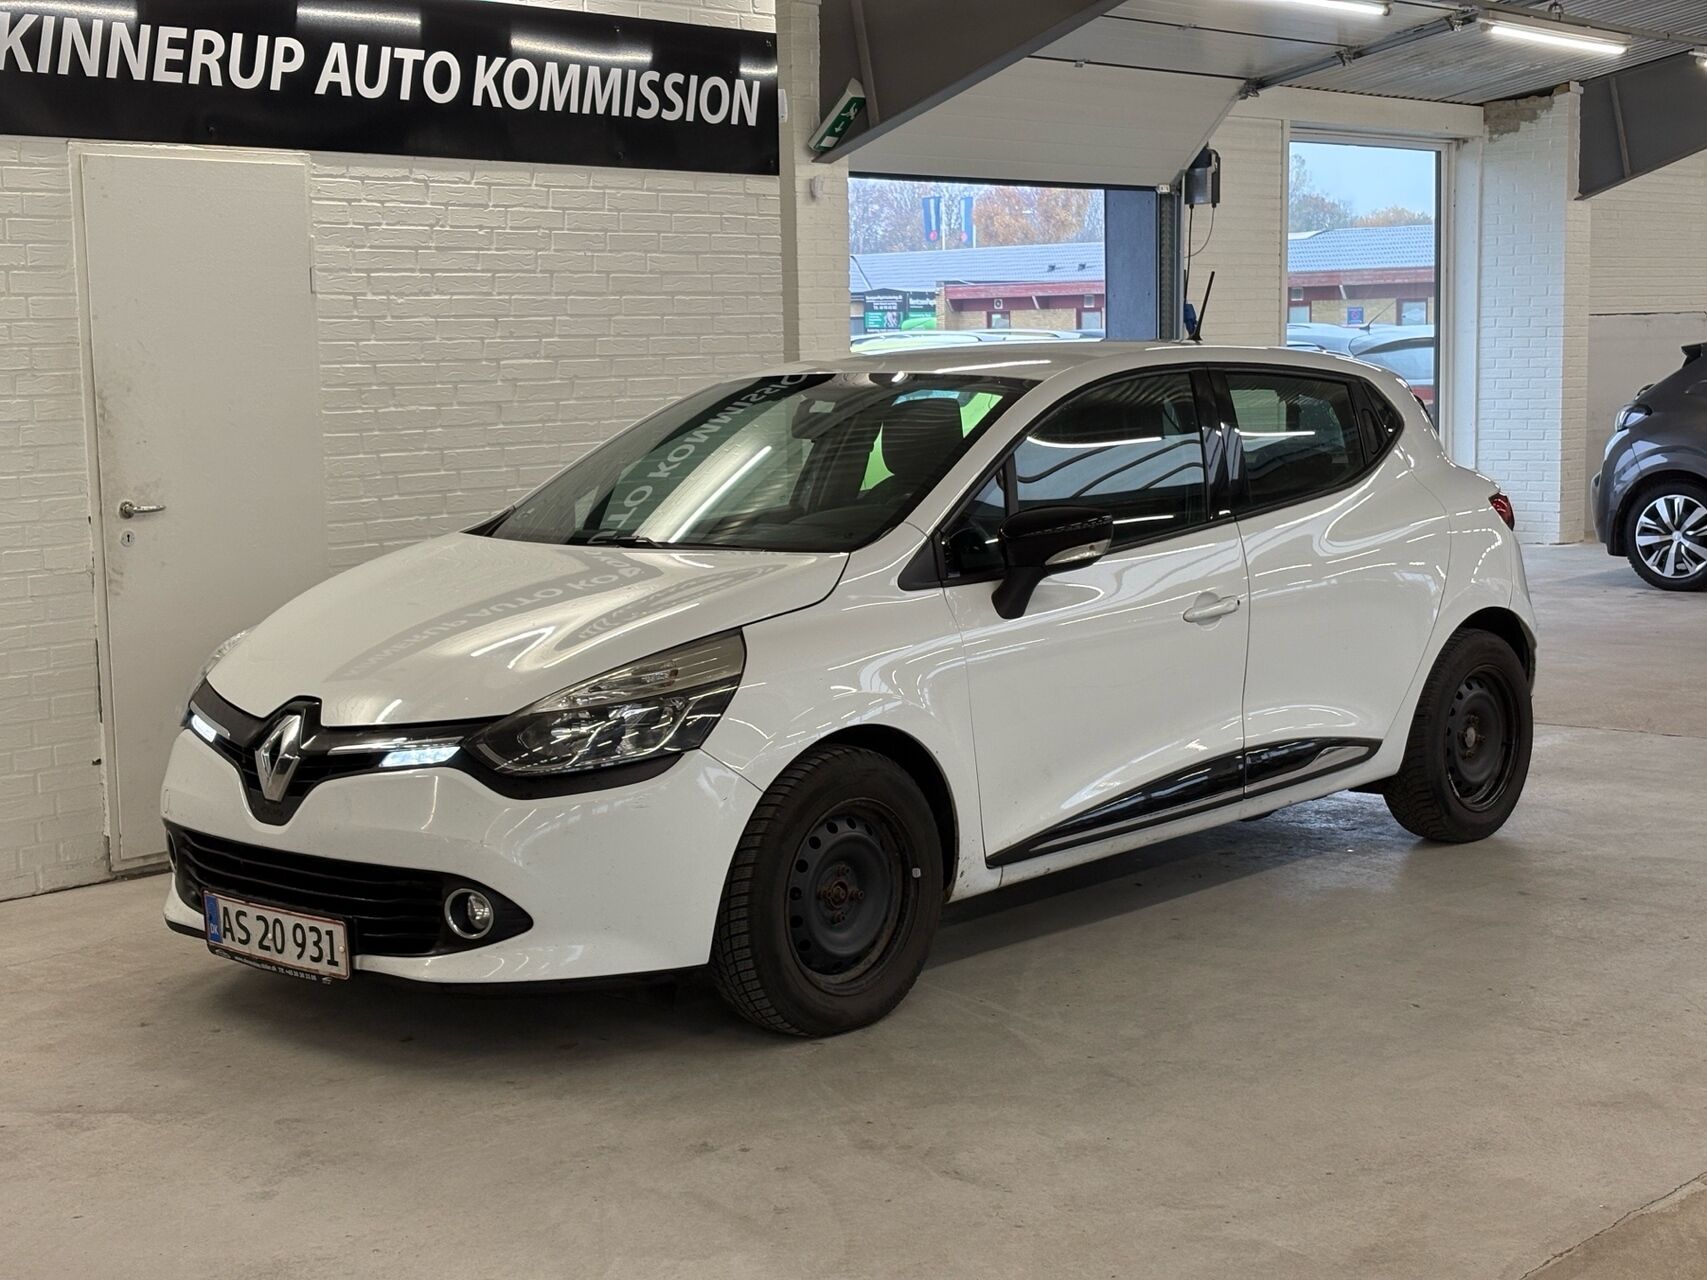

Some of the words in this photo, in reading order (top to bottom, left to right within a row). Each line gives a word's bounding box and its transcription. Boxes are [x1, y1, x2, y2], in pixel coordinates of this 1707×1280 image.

[314, 42, 461, 104] AUTO
[471, 56, 760, 128] KOMMISSION
[222, 906, 251, 946] AS
[256, 915, 286, 955] 20
[292, 922, 339, 967] 931
